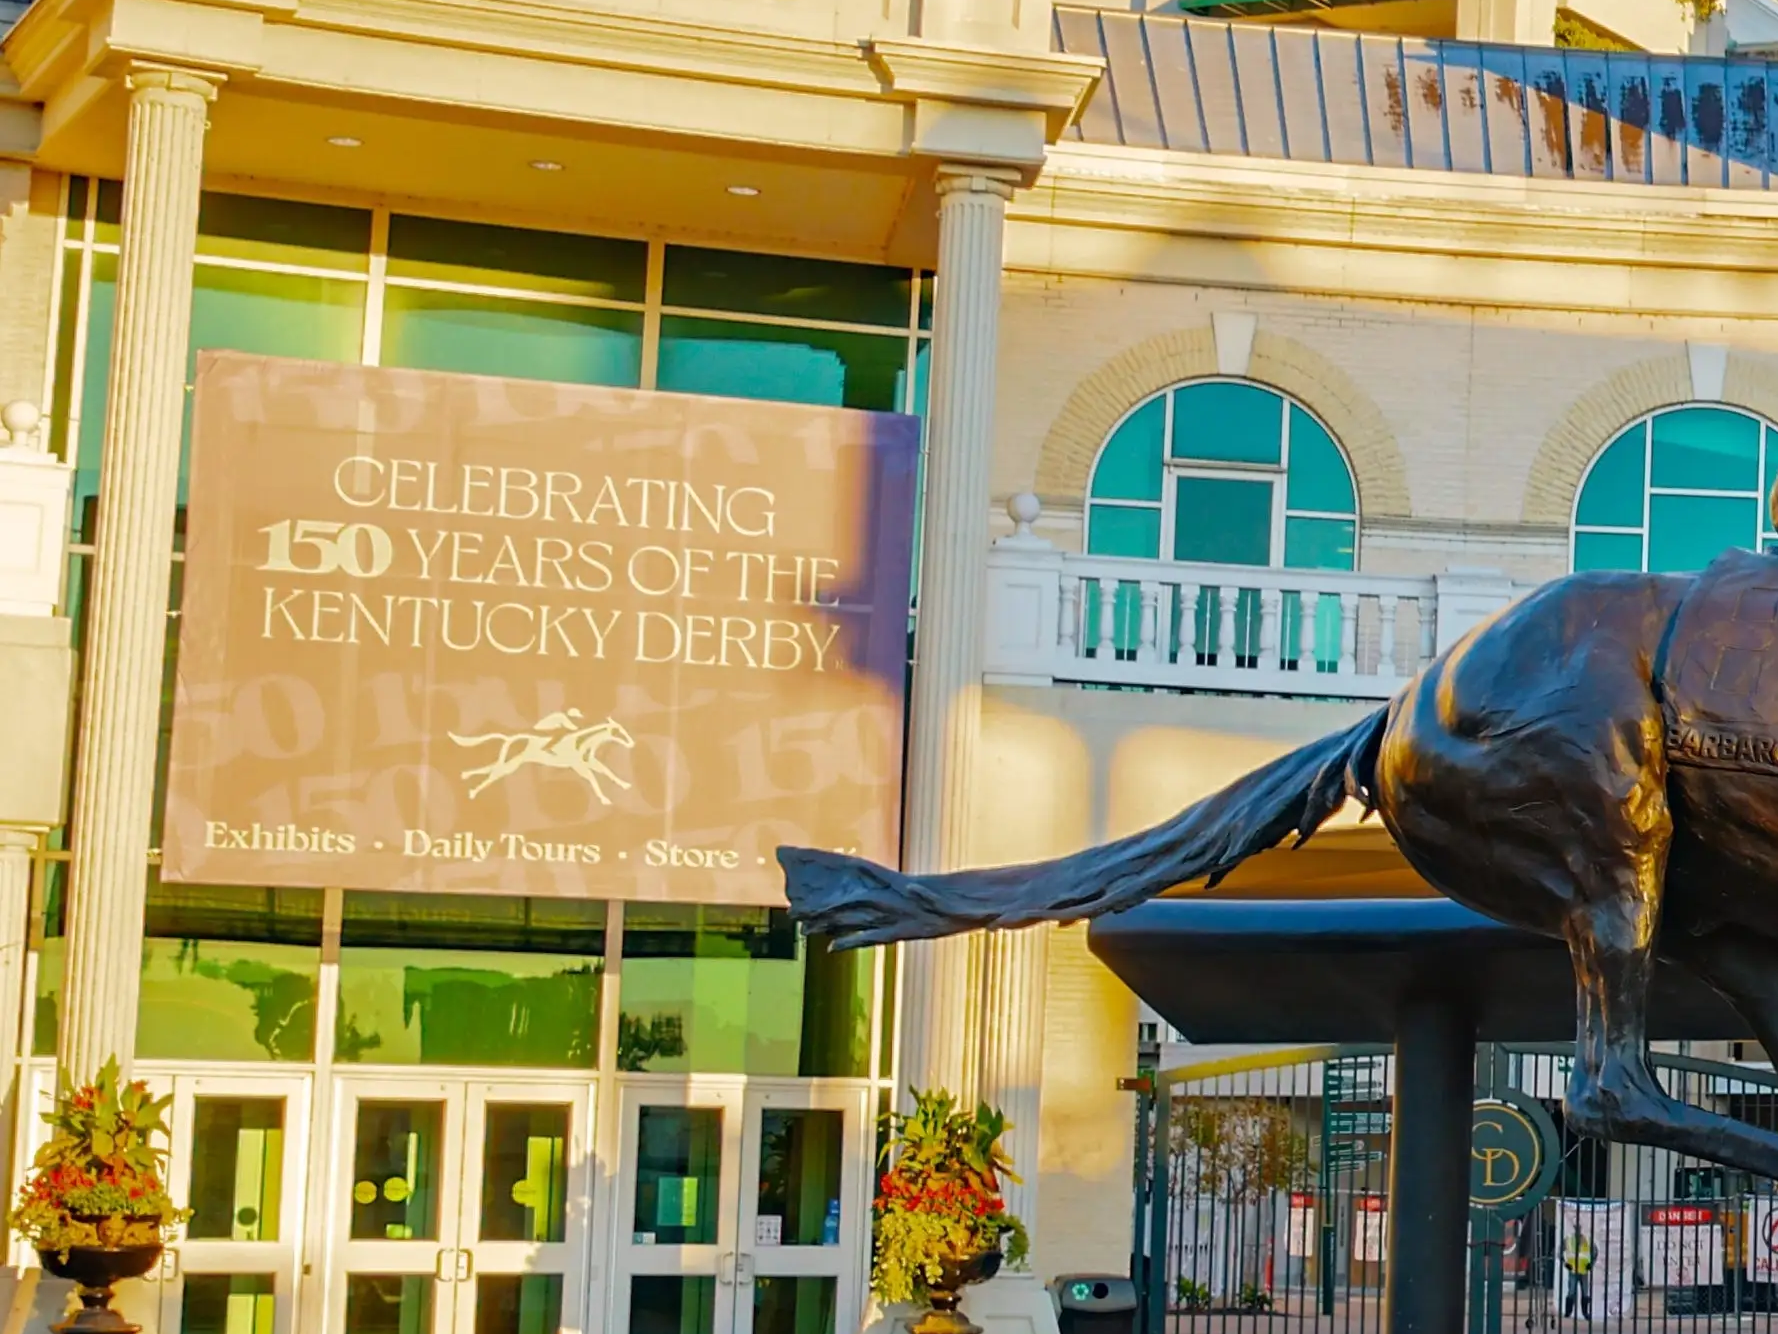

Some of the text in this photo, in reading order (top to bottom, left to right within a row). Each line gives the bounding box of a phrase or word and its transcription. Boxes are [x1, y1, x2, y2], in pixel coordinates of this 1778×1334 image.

[333, 455, 776, 539] CELEBRATING
[256, 519, 841, 608] 150 YEARS OF THE
[262, 587, 840, 673] KENTUCKY DERBY
[204, 820, 740, 870] Exhibits Daily Tours Store
